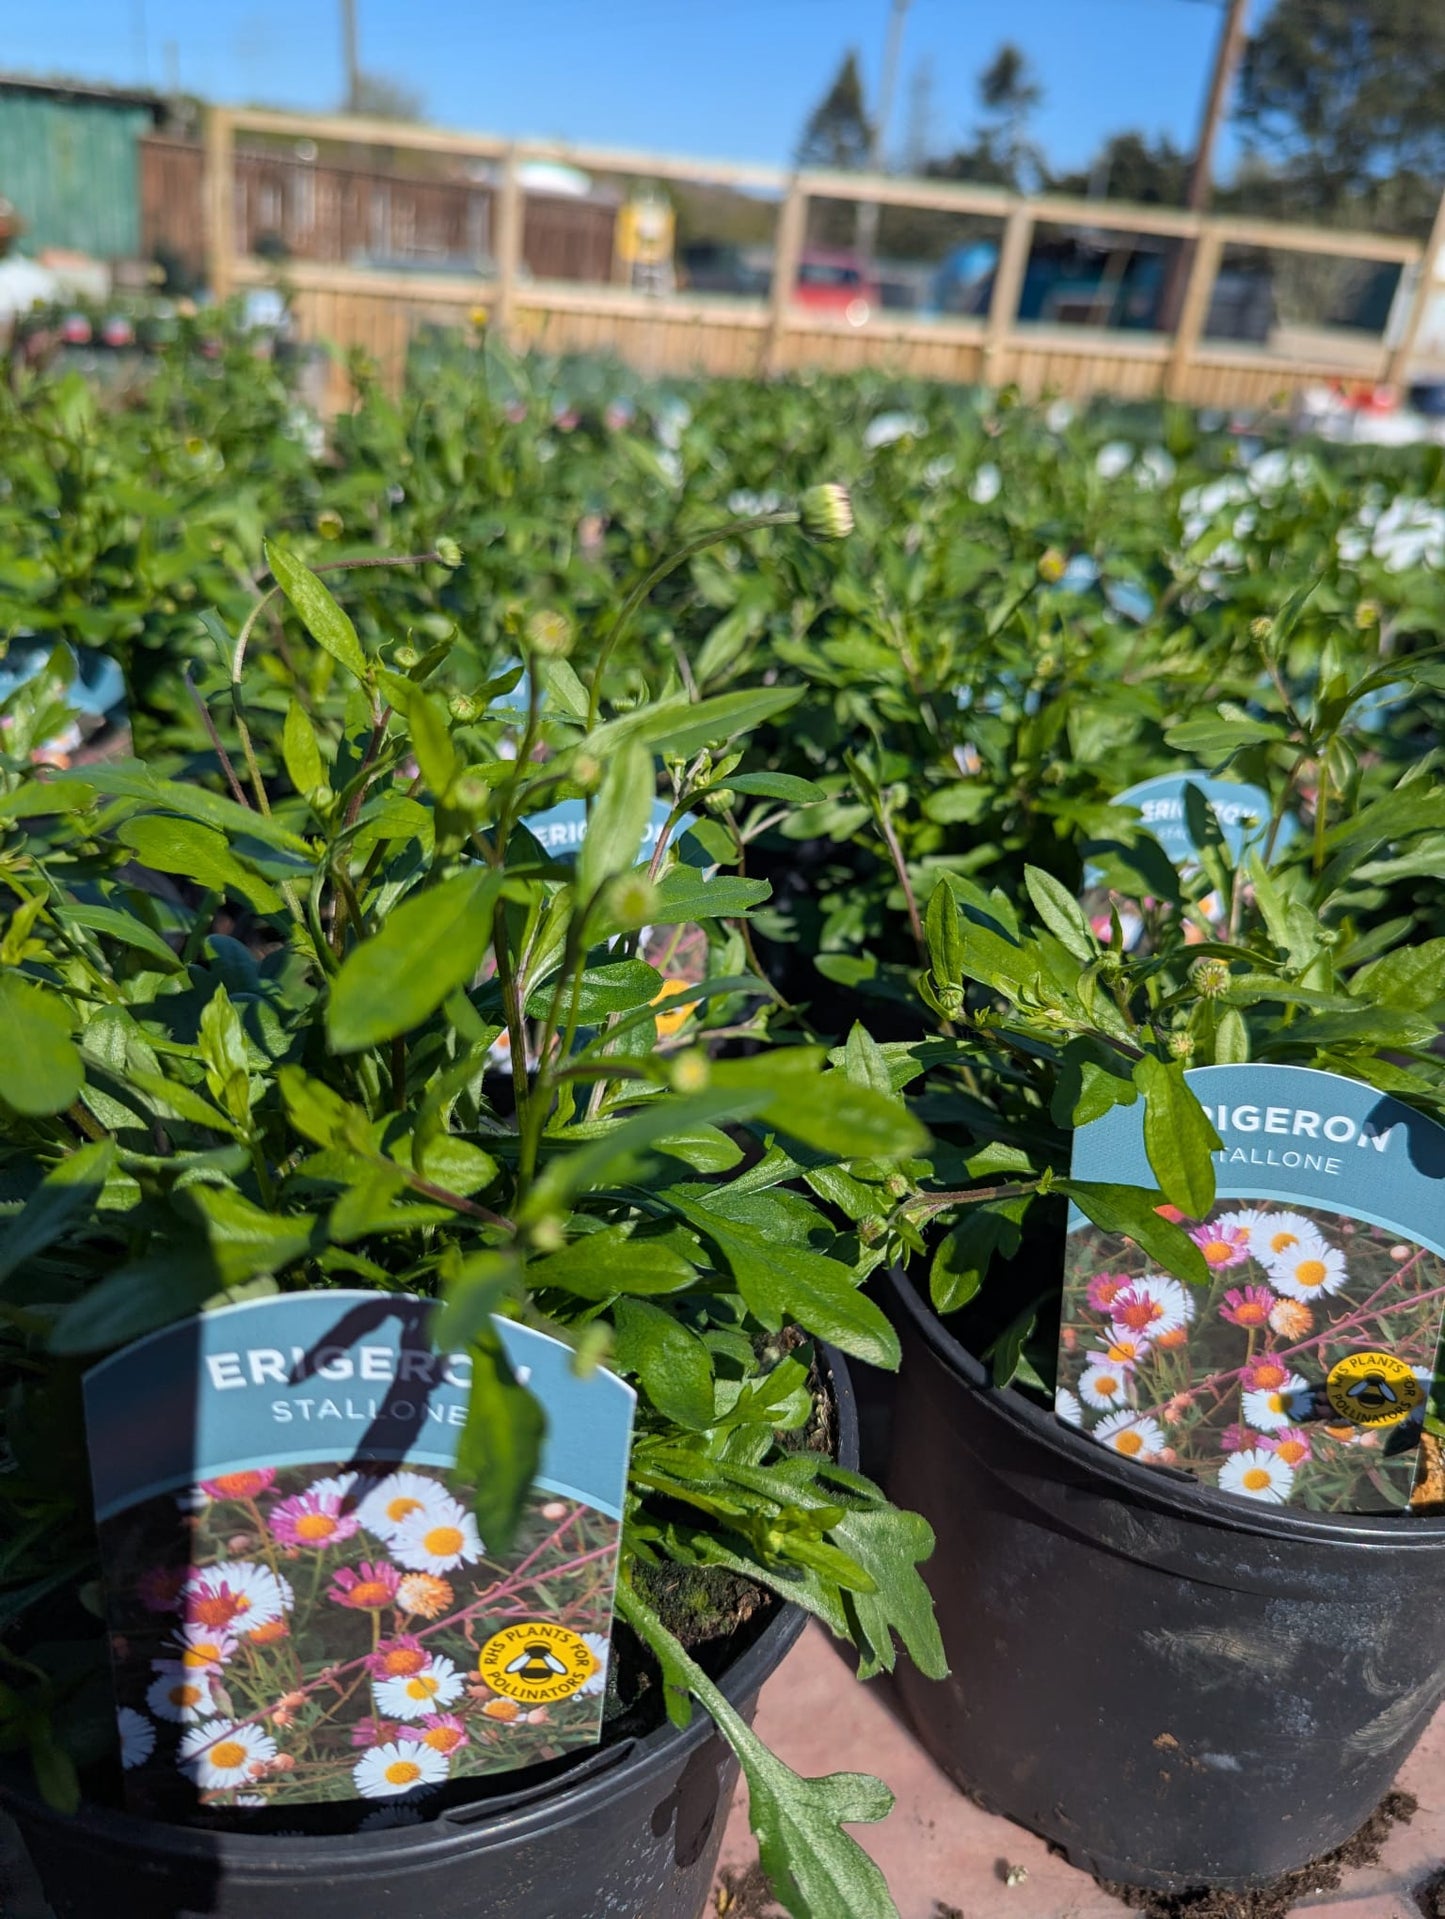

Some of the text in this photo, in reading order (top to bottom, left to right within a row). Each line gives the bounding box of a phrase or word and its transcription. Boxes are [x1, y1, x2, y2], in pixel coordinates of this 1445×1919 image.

[536, 820, 675, 846] ERION
[1201, 1104, 1393, 1152] IGERON
[1211, 1147, 1343, 1175] TALLONE
[206, 1346, 531, 1391] ERIGERO
[1349, 1355, 1404, 1373] PLANTS
[1403, 1374, 1416, 1397] FOR
[271, 1399, 469, 1426] STALLONE
[1331, 1394, 1411, 1423] POLLINATORS
[485, 1627, 590, 1667] RHS PLANTS FOR
[488, 1671, 586, 1699] POLLINATORS
